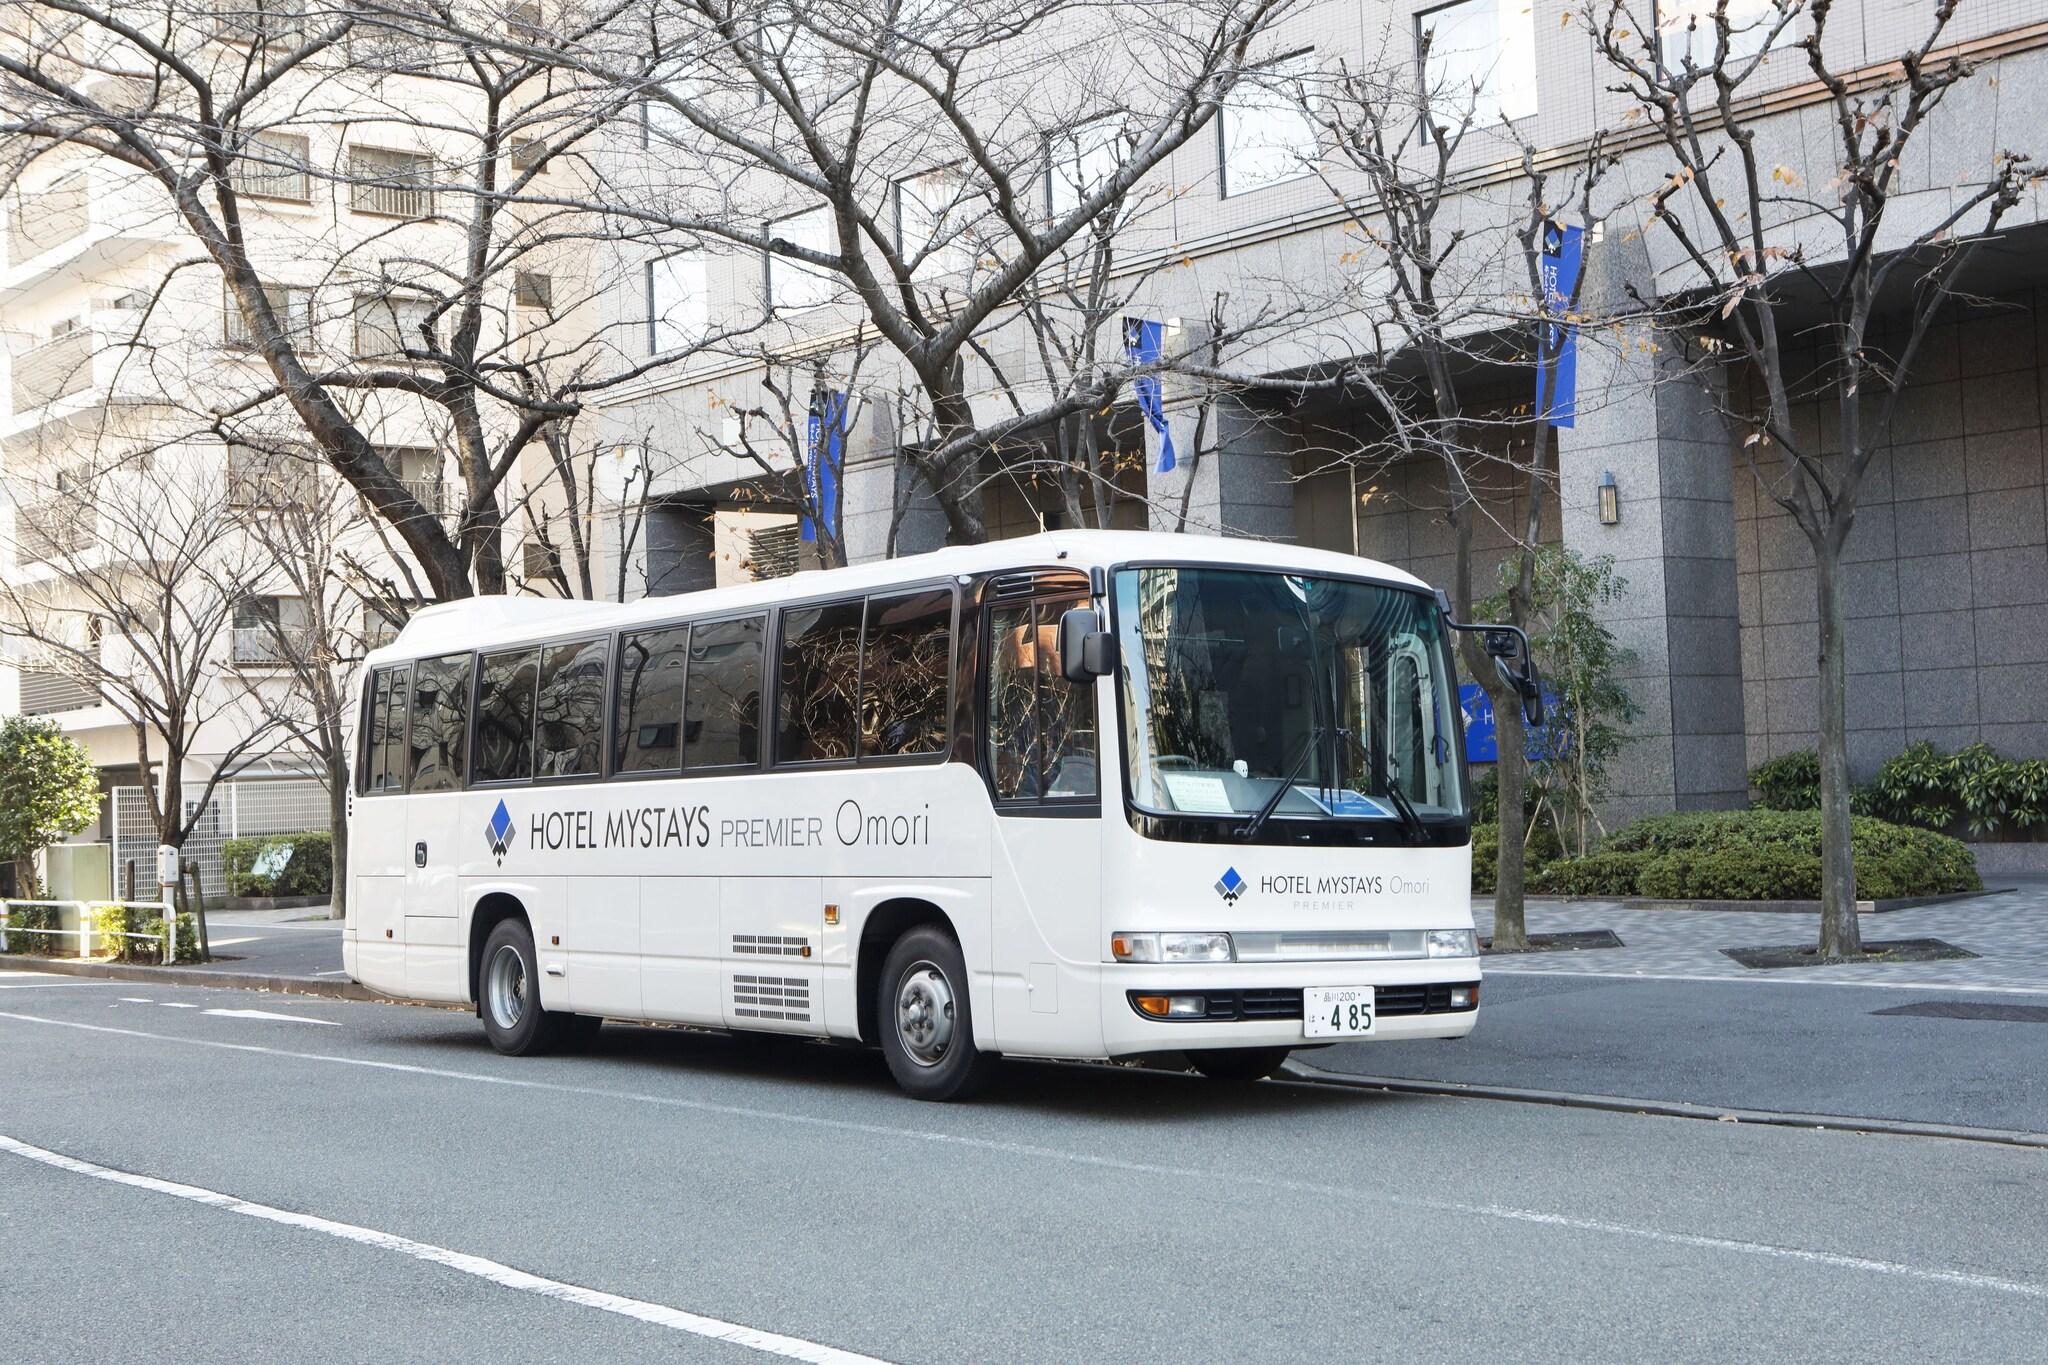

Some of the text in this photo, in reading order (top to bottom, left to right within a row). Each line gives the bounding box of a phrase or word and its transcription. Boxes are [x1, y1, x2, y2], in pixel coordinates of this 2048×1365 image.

[530, 799, 929, 851] HOTEL MYSTAYS PREMIER Omori
[1261, 875, 1430, 895] HOTEL MYSTAYS Omori
[1293, 900, 1355, 911] PREMIER
